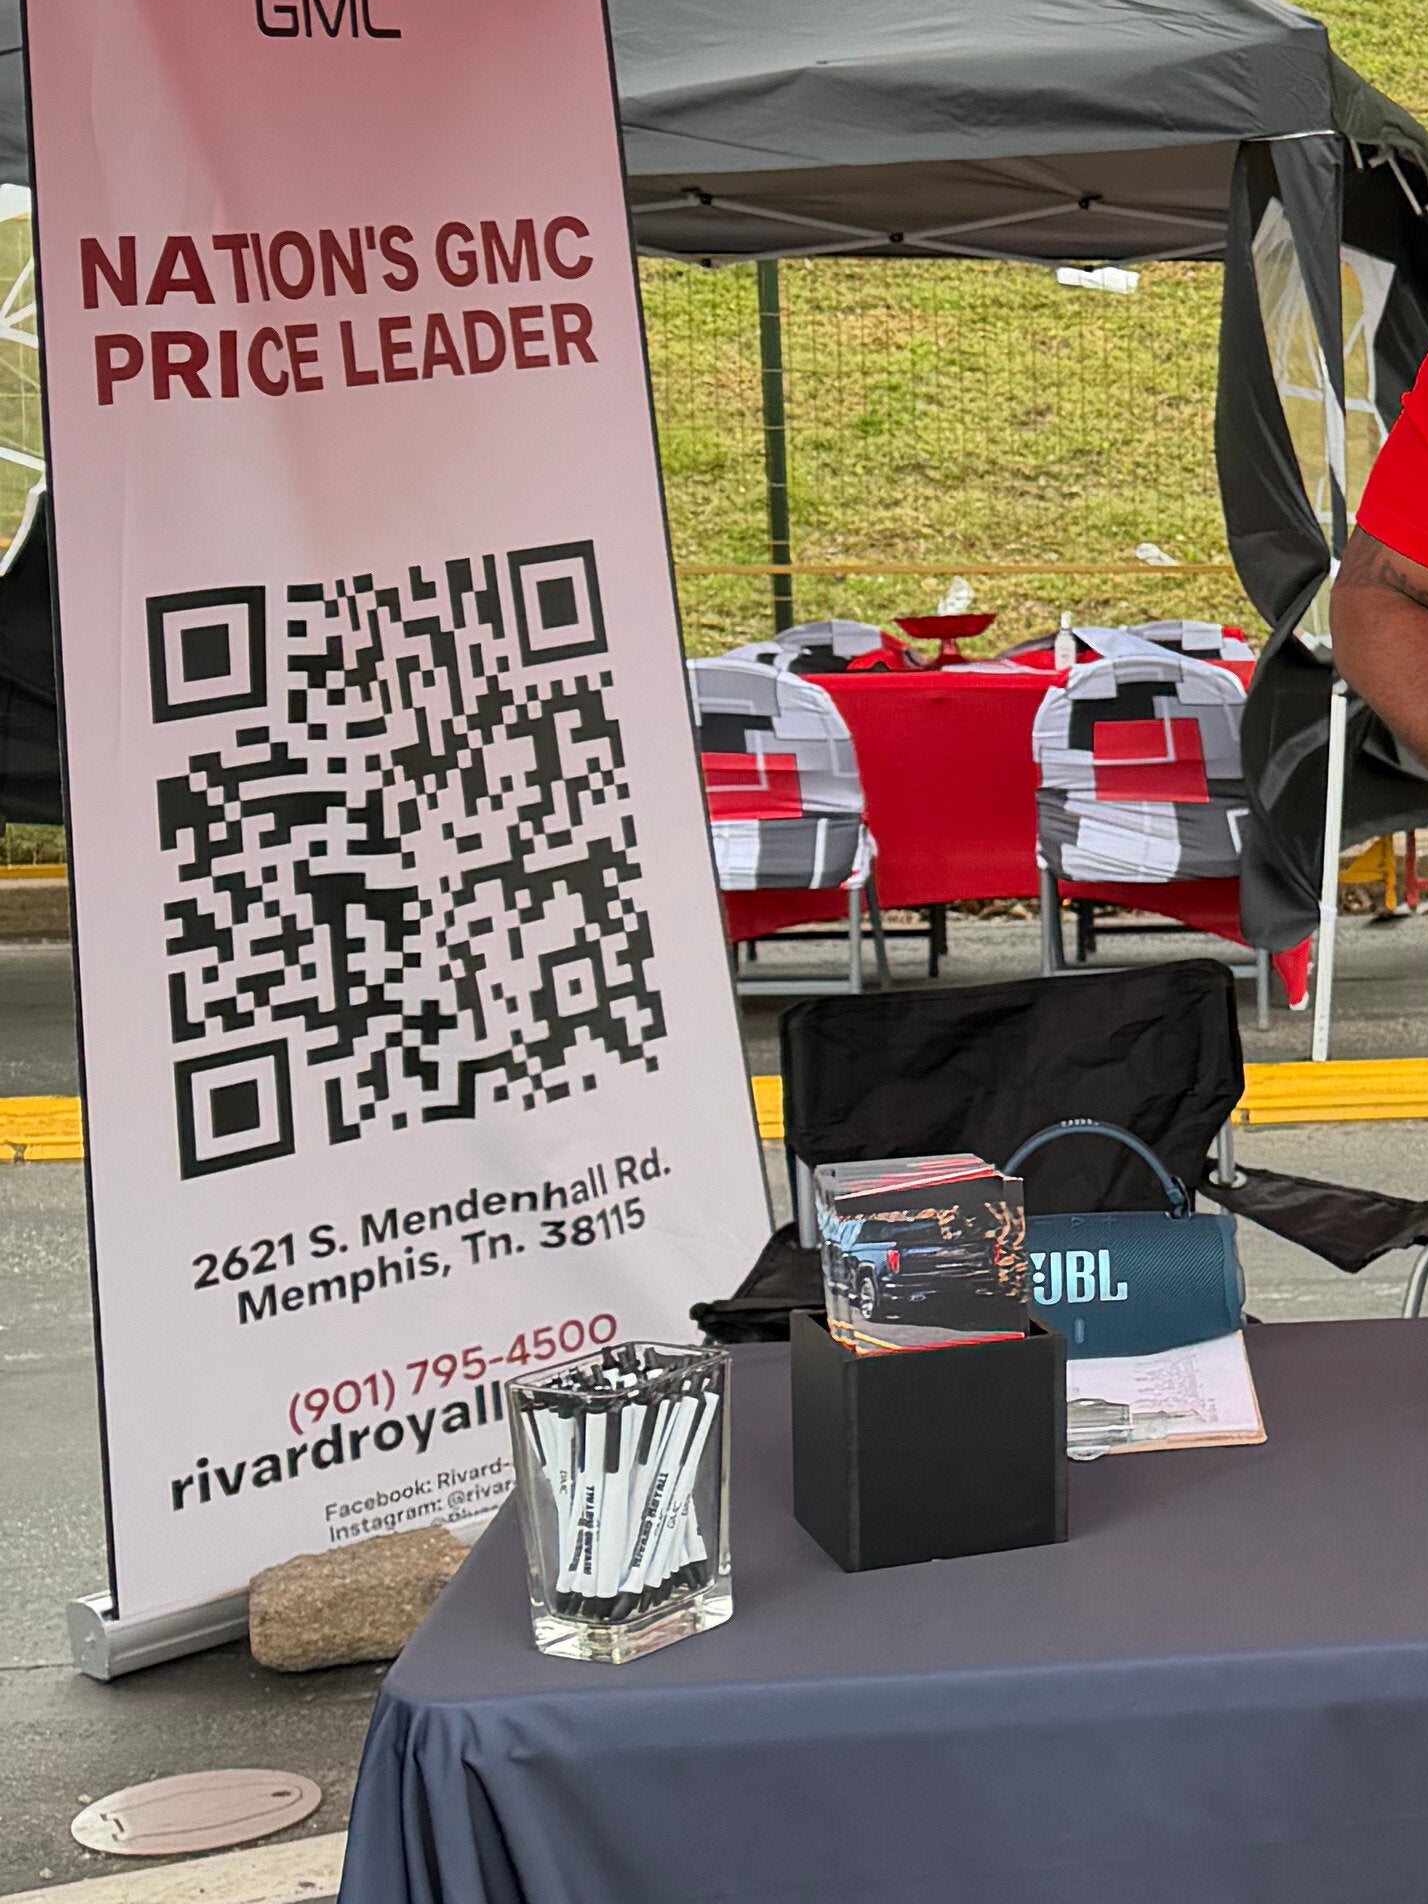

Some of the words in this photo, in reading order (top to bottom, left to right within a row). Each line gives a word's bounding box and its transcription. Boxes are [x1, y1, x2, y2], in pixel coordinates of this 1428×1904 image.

[80, 225, 420, 309] NATION'S
[435, 215, 594, 288] GMC
[94, 323, 324, 406] PRICE
[339, 302, 598, 387] LEADER
[191, 1232, 295, 1290] 2621
[308, 1224, 349, 1259] S.
[361, 1163, 608, 1248] Mendenhall
[614, 1146, 672, 1189] Rd.
[237, 1245, 452, 1325] Memphis,
[461, 1228, 525, 1265] Tn.
[539, 1197, 646, 1249] 38115
[1030, 1249, 1128, 1306] JBL
[288, 1368, 396, 1435] (901)
[406, 1312, 618, 1396] 795-4500
[325, 1479, 432, 1522] Facebook:
[329, 1498, 443, 1543] Instagram:
